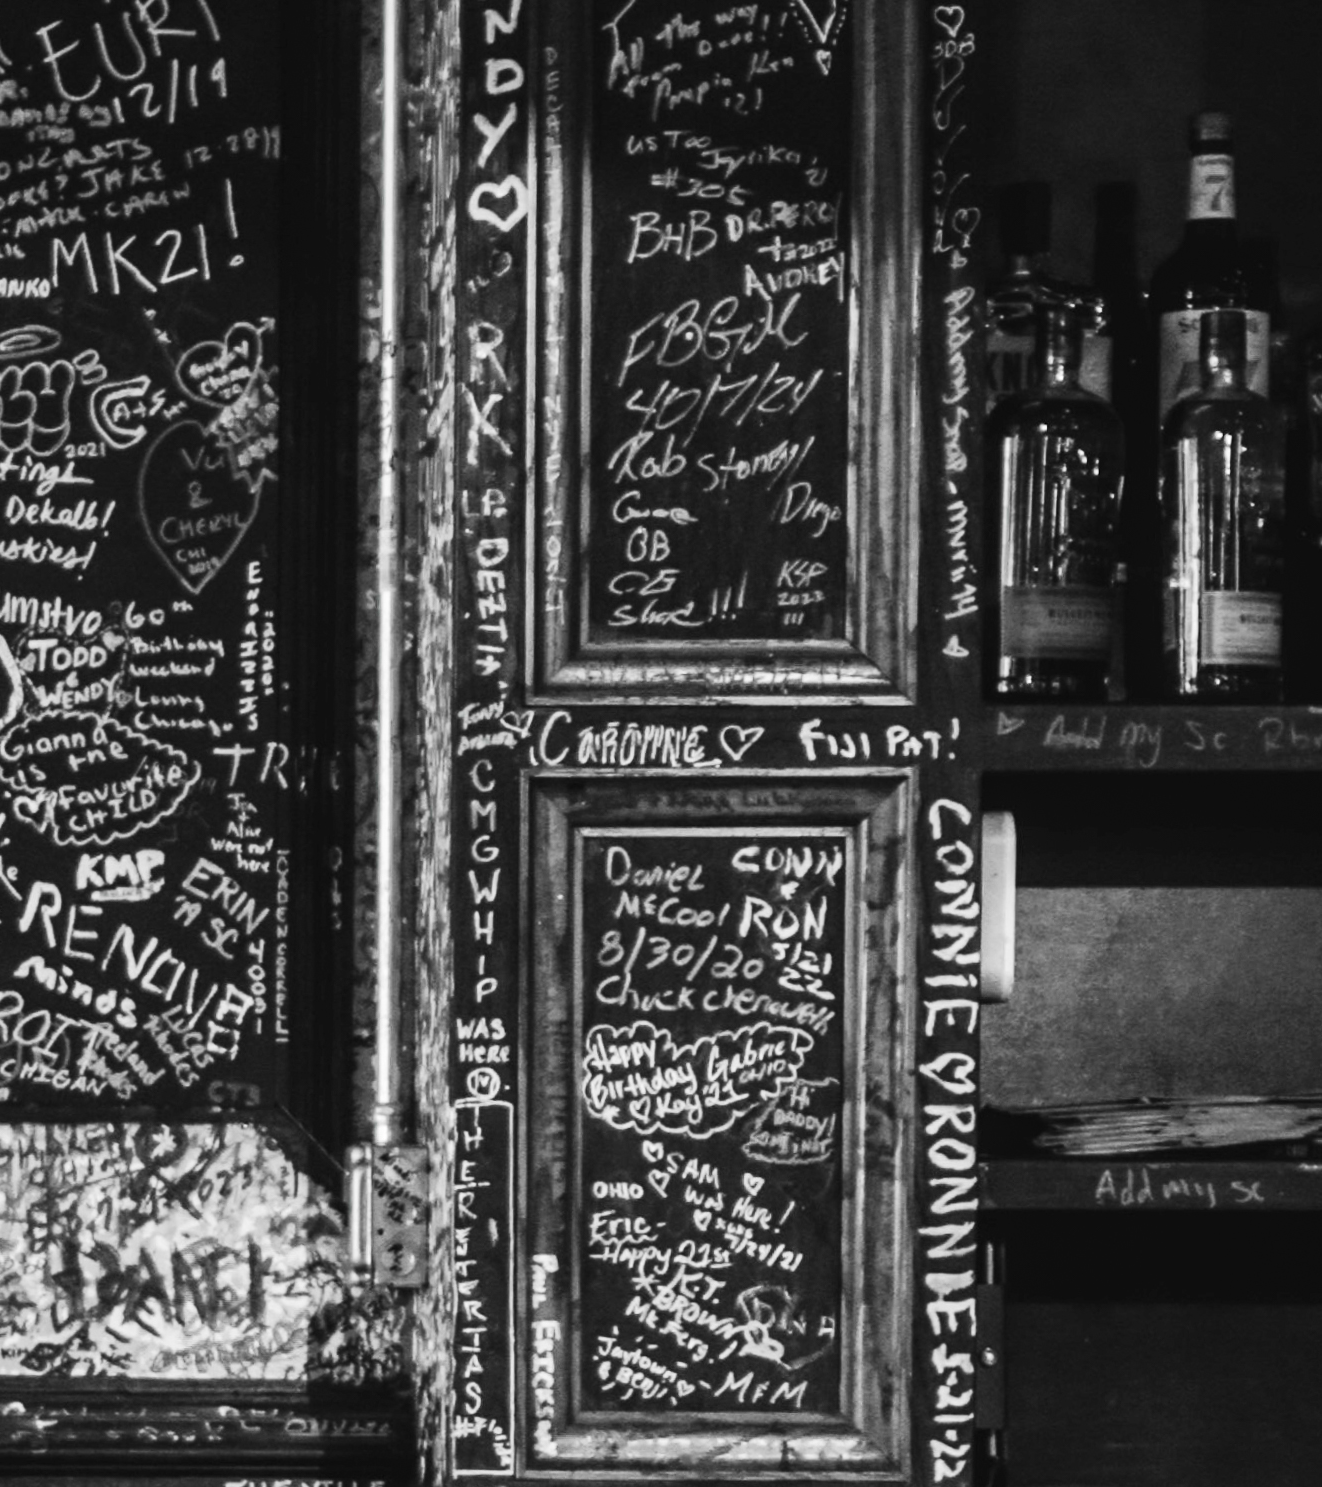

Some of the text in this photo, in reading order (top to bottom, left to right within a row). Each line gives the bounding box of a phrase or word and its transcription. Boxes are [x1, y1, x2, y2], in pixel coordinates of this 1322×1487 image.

[628, 210, 718, 263] BHB
[160, 512, 247, 543] CHERYL
[28, 638, 107, 671] TODD
[34, 674, 121, 709] WENDY
[799, 718, 871, 761] FIJI
[77, 849, 166, 890] KMP
[183, 857, 270, 935] ERIN
[923, 797, 980, 1037] CONNIE
[738, 895, 828, 941] RON
[598, 928, 765, 981] 8/30/20
[590, 1038, 658, 1072] Happy
[589, 1061, 699, 1110] Birthday
[592, 1180, 644, 1200] OHIO
[666, 1151, 720, 1188] SAM
[1094, 1169, 1154, 1205] Add
[918, 1103, 979, 1337] RONNIE
